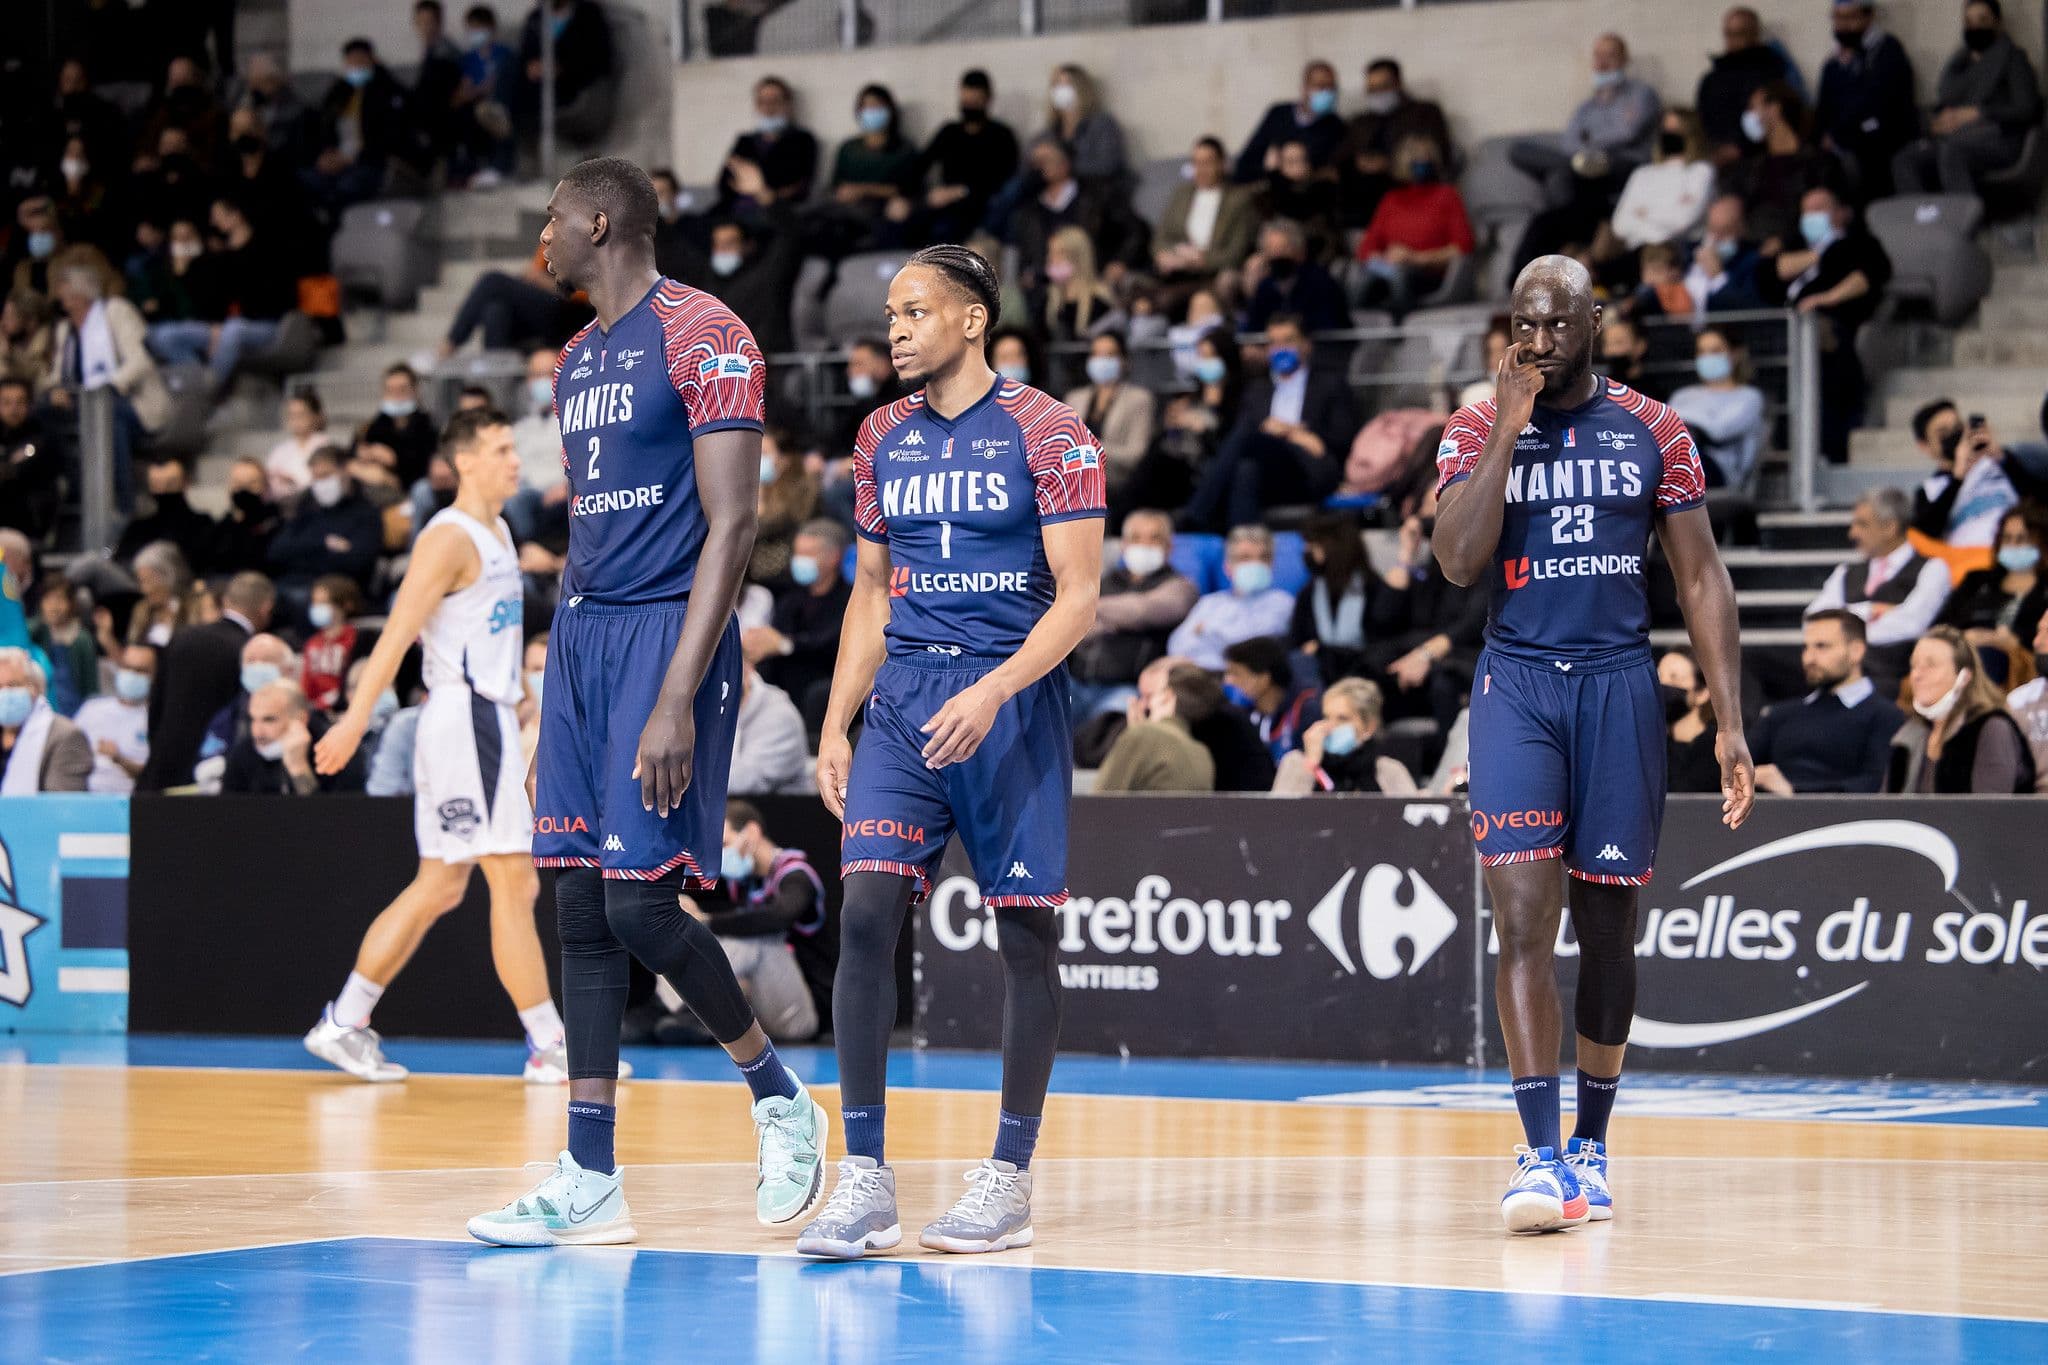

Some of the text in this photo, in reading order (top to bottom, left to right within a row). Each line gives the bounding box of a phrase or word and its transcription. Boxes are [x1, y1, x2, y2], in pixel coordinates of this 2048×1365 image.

[562, 383, 634, 436] NANTES
[587, 436, 600, 481] 2
[883, 471, 1010, 518] NANTES
[1505, 459, 1643, 504] NANTES
[938, 520, 952, 559] 1
[1551, 504, 1595, 545] 23
[911, 572, 1028, 593] LEGENDRE
[1533, 555, 1641, 580] LEGENDRE
[847, 819, 925, 846] VEOLIA
[1490, 810, 1564, 830] VEOLIA
[930, 875, 1292, 956] Crefour
[1815, 897, 1911, 963] du
